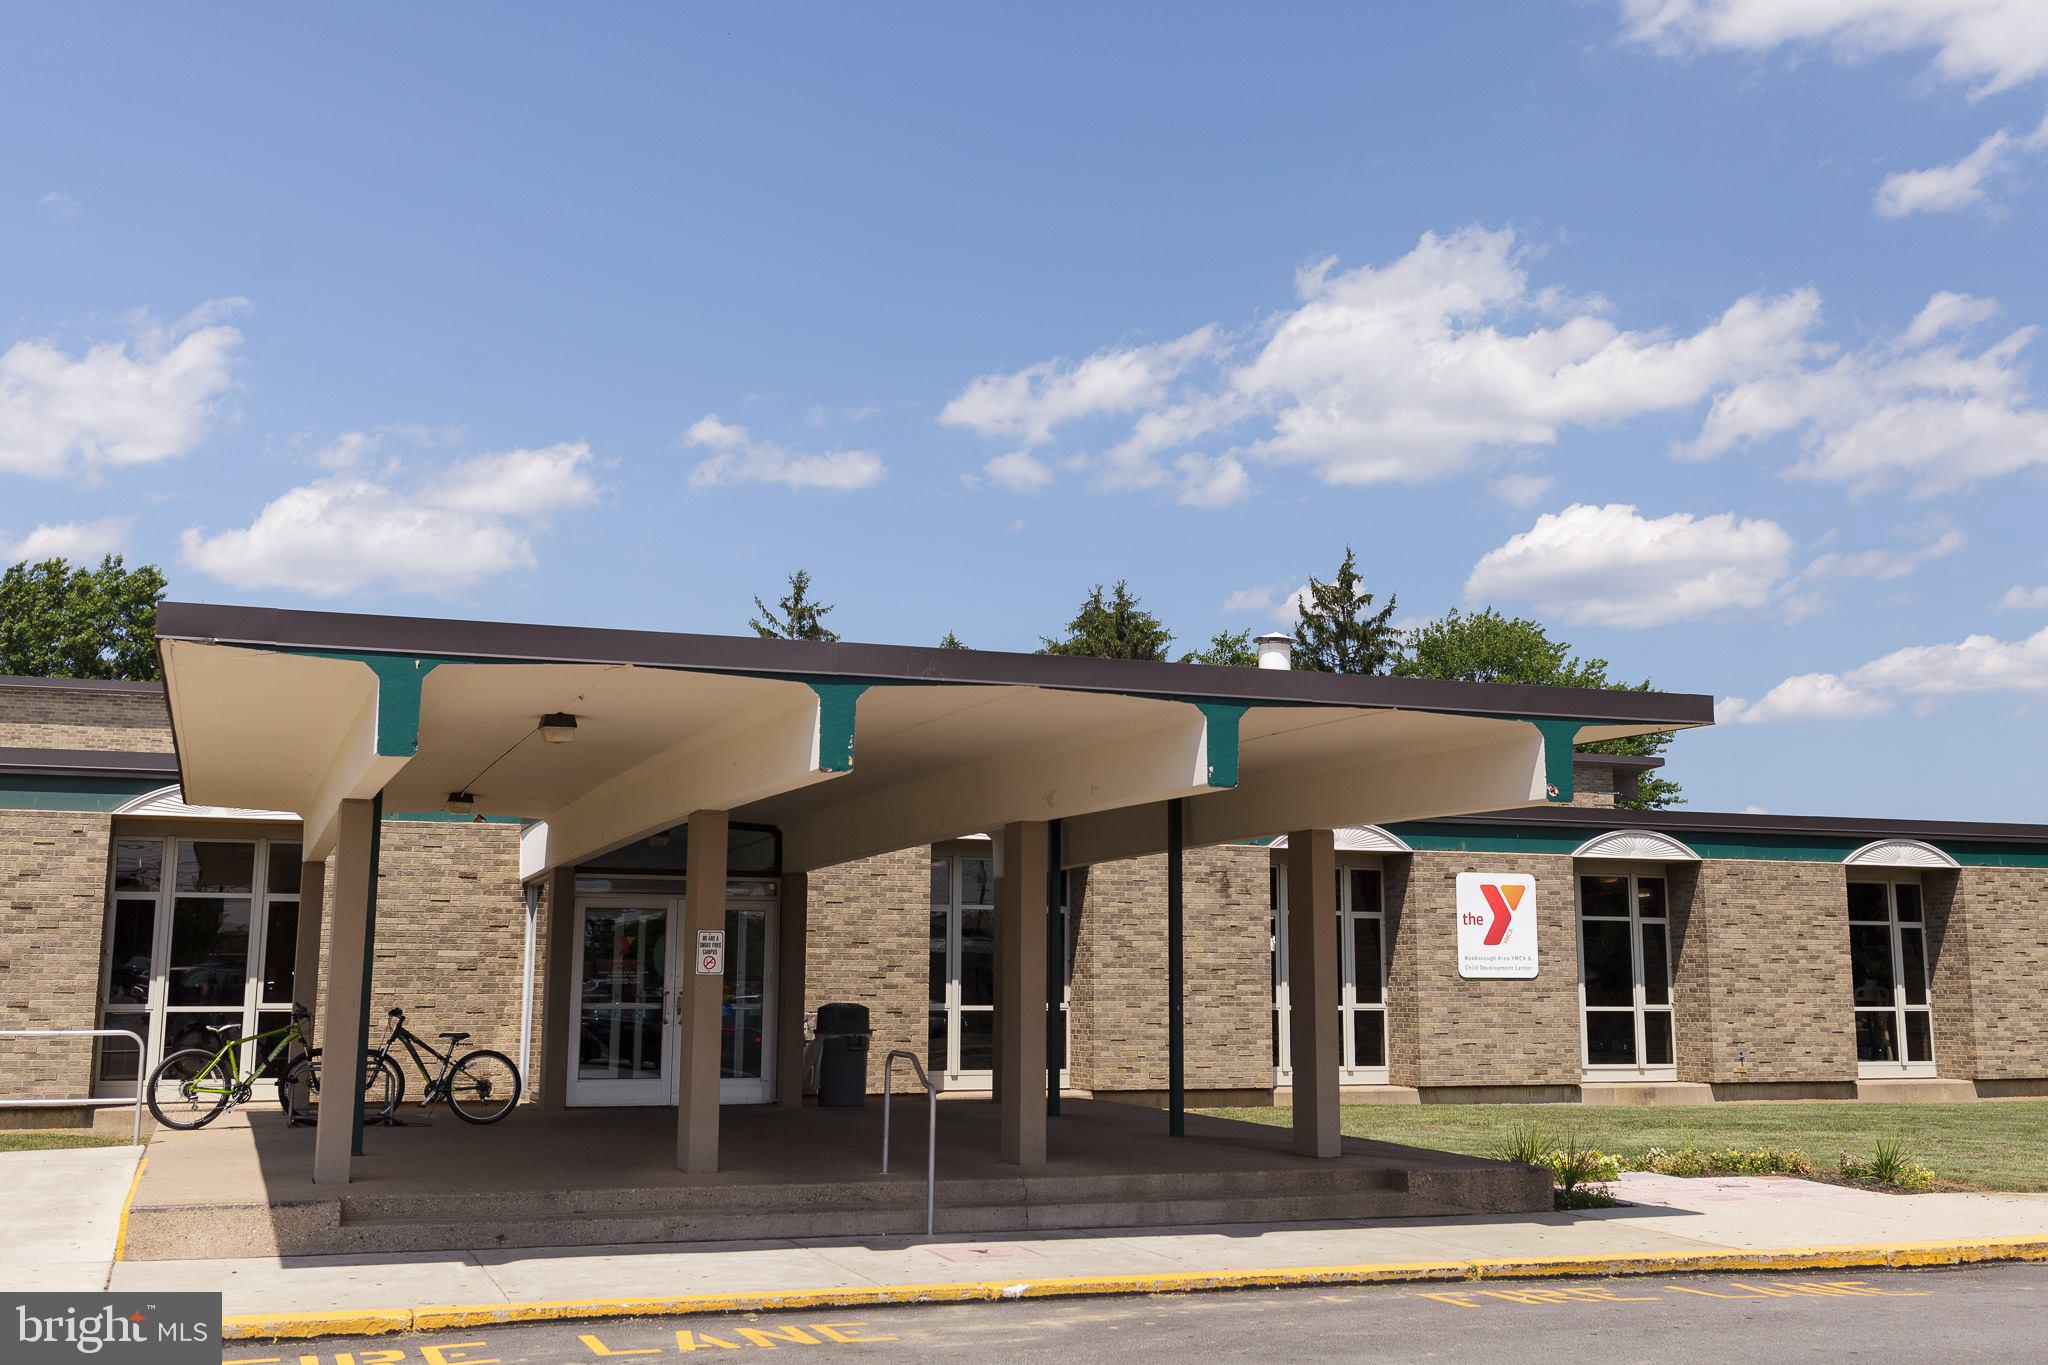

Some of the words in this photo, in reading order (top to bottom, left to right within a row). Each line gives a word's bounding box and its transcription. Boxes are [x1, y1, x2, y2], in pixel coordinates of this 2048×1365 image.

[1462, 912, 1484, 926] the
[1503, 928, 1513, 945] YMCA
[577, 1322, 900, 1356] LANE
